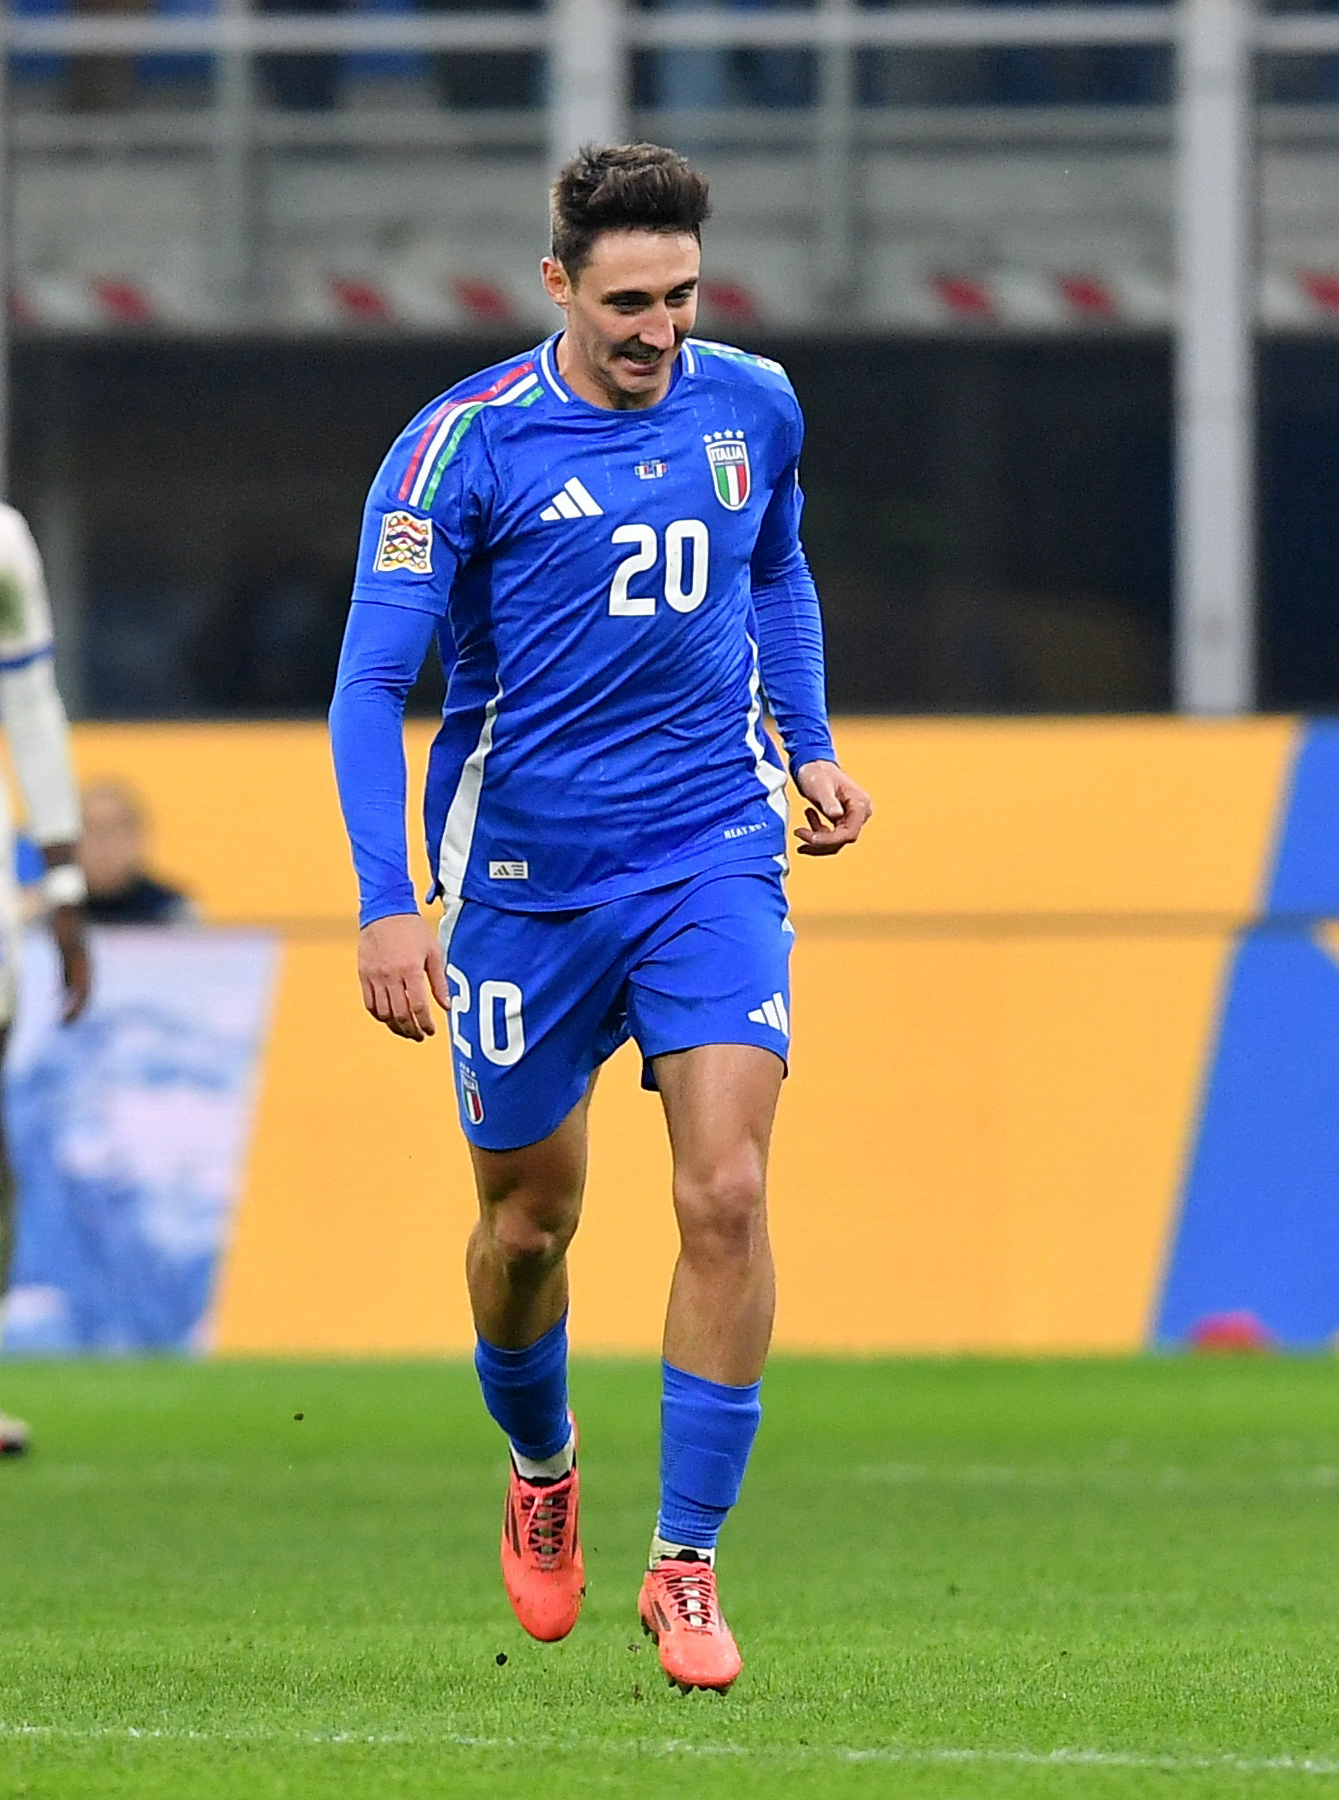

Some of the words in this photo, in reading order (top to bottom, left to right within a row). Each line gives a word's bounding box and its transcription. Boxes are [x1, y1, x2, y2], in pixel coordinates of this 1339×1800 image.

[710, 445, 744, 461] ITALIA
[608, 518, 710, 616] 20
[446, 963, 525, 1066] 20
